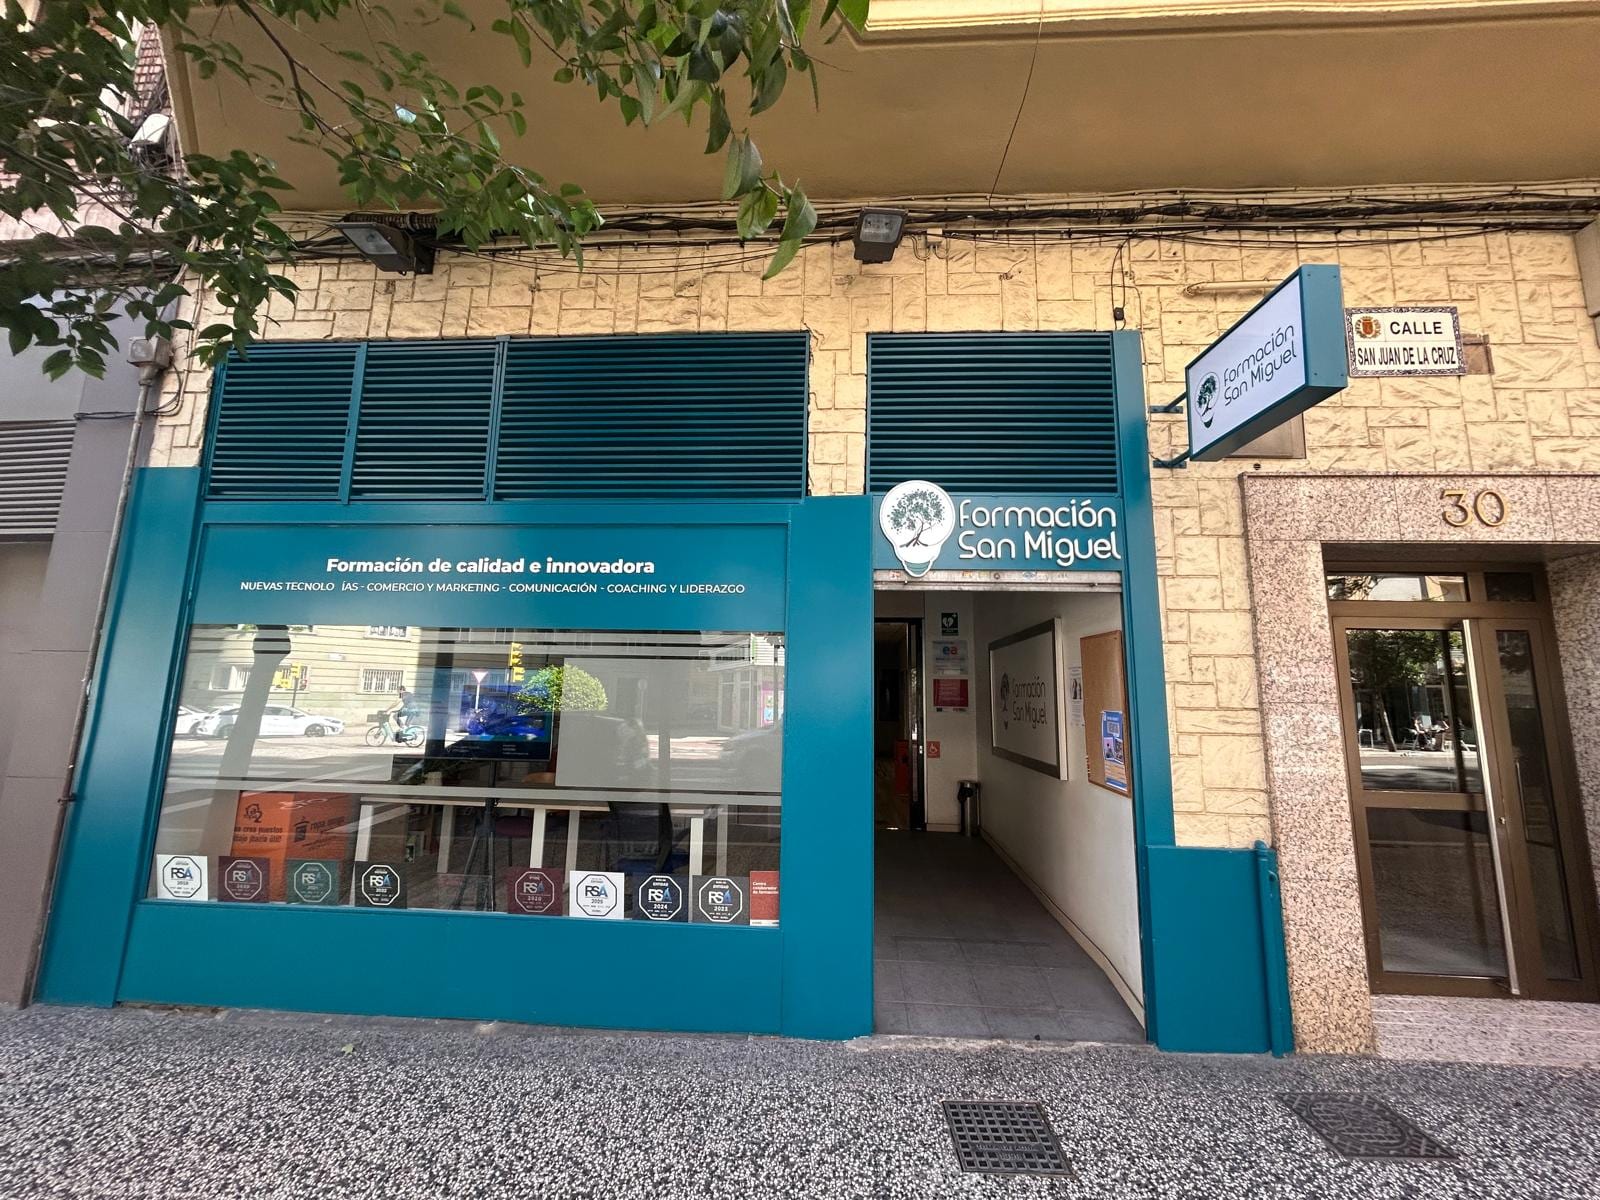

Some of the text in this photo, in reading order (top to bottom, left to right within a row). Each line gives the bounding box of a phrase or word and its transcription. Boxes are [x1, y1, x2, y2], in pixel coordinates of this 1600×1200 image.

[1389, 321, 1443, 335] CALLE
[1223, 325, 1295, 387] Formación
[1357, 346, 1456, 365] SAN JUAN DE LA CRUZ
[1223, 340, 1297, 407] San Miguel
[958, 499, 1118, 529] Formación
[1440, 489, 1506, 528] 30
[958, 530, 1123, 567] San Miguel
[326, 557, 655, 574] Formación de calidad e innovadora
[240, 581, 283, 591] NUEVAS
[366, 582, 425, 593] COMERCIO
[426, 583, 435, 592] Y
[435, 583, 500, 593] MARKETING
[508, 582, 598, 593] COMUNICACIÓN
[607, 584, 667, 594] COACHING
[669, 584, 678, 594] Y
[679, 584, 746, 594] LIDERAZGO
[171, 867, 193, 879] RSA
[369, 874, 391, 887] RSA
[523, 881, 545, 894] RSA
[584, 884, 609, 898] RSA
[648, 887, 672, 902] RSA
[708, 889, 732, 905] RSA
